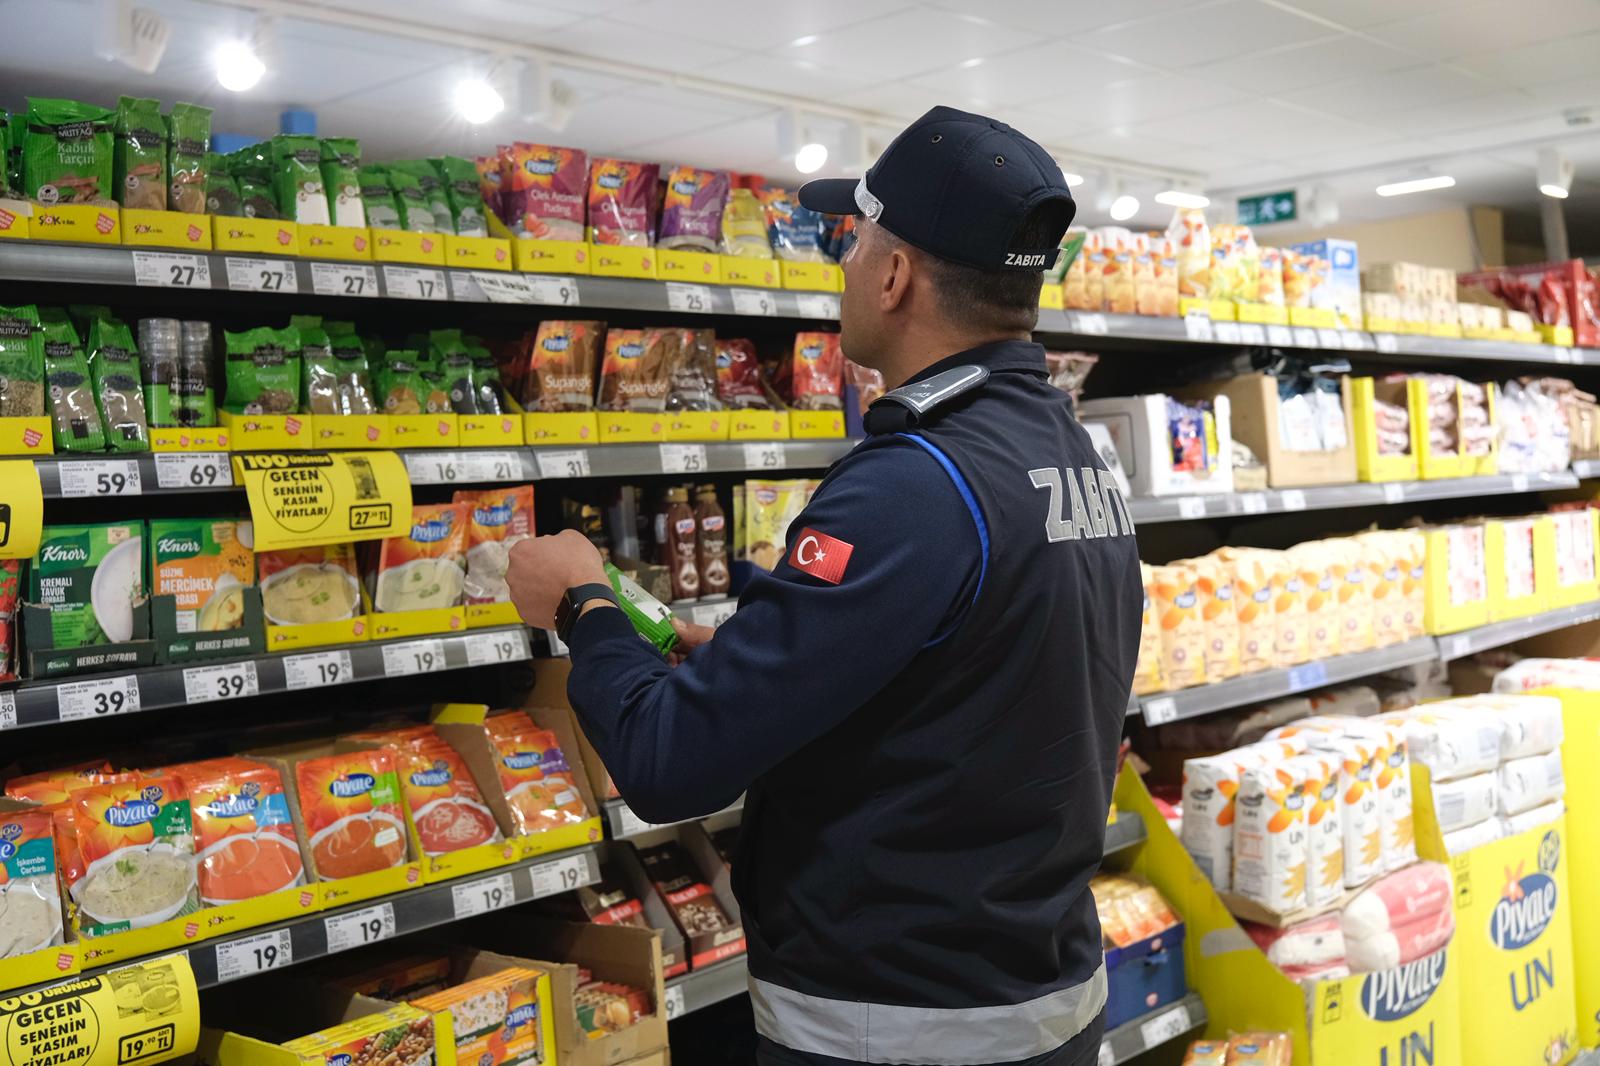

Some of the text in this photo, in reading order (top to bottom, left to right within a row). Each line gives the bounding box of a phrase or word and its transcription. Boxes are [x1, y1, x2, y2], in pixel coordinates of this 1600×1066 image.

[58, 142, 95, 153] Kabuk
[58, 152, 95, 167] Tarçın
[1005, 252, 1046, 266] ZABITA
[170, 265, 195, 286] 27
[260, 271, 283, 290] 27
[343, 275, 365, 294] 27
[417, 279, 434, 298] 17
[559, 287, 570, 304] 9
[686, 294, 703, 311] 25
[244, 454, 289, 469] 100
[683, 455, 699, 471] 25
[761, 451, 777, 467] 25
[190, 464, 217, 485] 69
[270, 470, 319, 484] GEÇEN
[436, 463, 456, 481] 16
[494, 462, 512, 479] 21
[97, 472, 126, 494] 59
[273, 484, 323, 496] SENENİN
[283, 495, 318, 506] KASIM
[276, 507, 328, 519] FİYATLARI
[355, 511, 388, 525] 27 TL
[41, 544, 88, 562] Knorr
[158, 538, 201, 553] Knorr
[40, 577, 73, 588] KREMALI
[41, 587, 65, 596] TAVUK
[160, 576, 214, 592] MERCİMEK
[195, 636, 251, 652] HERKES SOFRAYA
[494, 642, 513, 660] 19
[77, 651, 137, 667] HERKES SOFRAYA
[413, 651, 433, 671] 19
[318, 662, 339, 684] 19
[217, 674, 244, 697] 39
[94, 690, 124, 715] 39
[332, 776, 373, 796] Piyale
[109, 803, 156, 825] Piyale
[211, 798, 256, 817] Piyale
[16, 856, 46, 867] İşkembe
[20, 865, 47, 875] Çorbası
[559, 868, 578, 889] 19
[482, 888, 502, 909] 19
[1496, 881, 1555, 949] Piyale
[360, 918, 382, 942] 19
[253, 945, 277, 970] 19
[1509, 948, 1554, 1012] UN
[16, 999, 82, 1028] GEÇEN
[20, 1018, 86, 1046] SENENİN
[32, 1034, 78, 1056] KASIM
[126, 1039, 144, 1059] 19
[157, 1037, 169, 1049] TL
